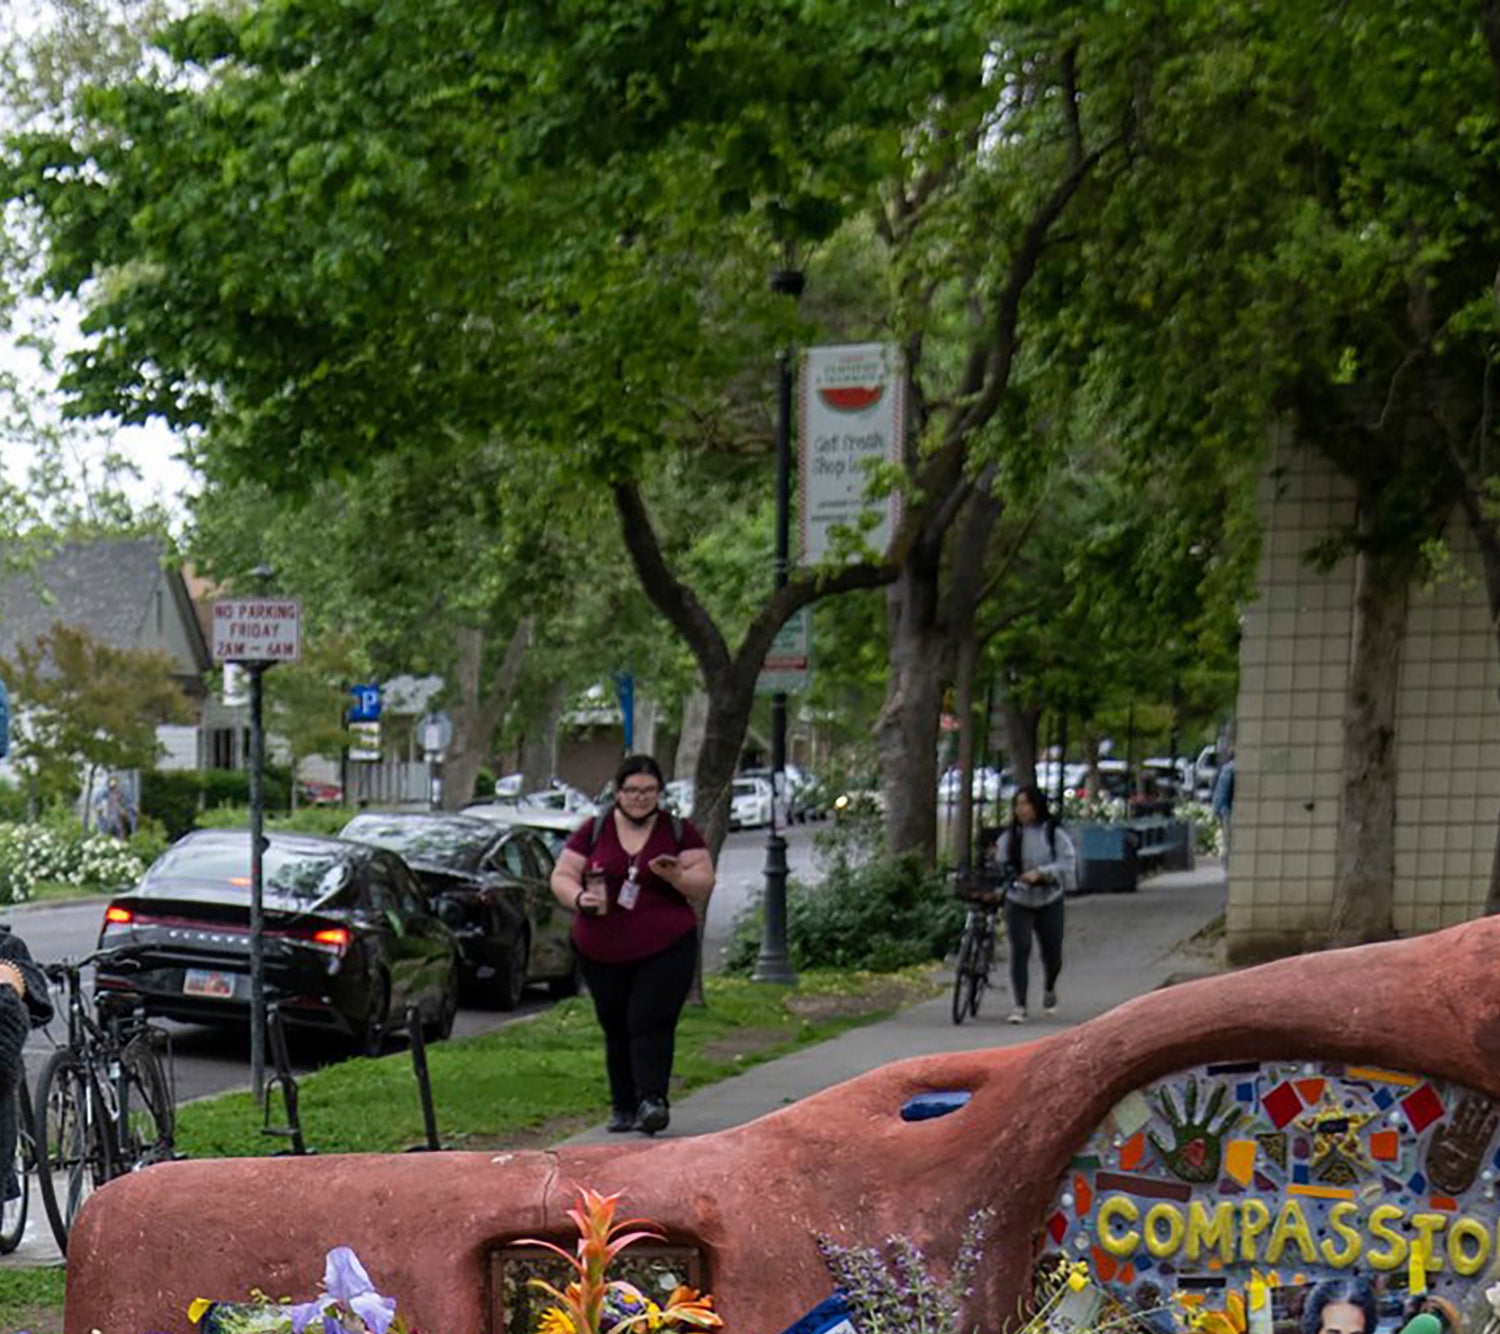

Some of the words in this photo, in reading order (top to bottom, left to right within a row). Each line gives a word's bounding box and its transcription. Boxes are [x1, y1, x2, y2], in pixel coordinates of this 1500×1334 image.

[214, 605, 233, 619] NO
[239, 604, 295, 620] PARKING
[230, 623, 280, 637] FRIDAY
[363, 691, 377, 713] P
